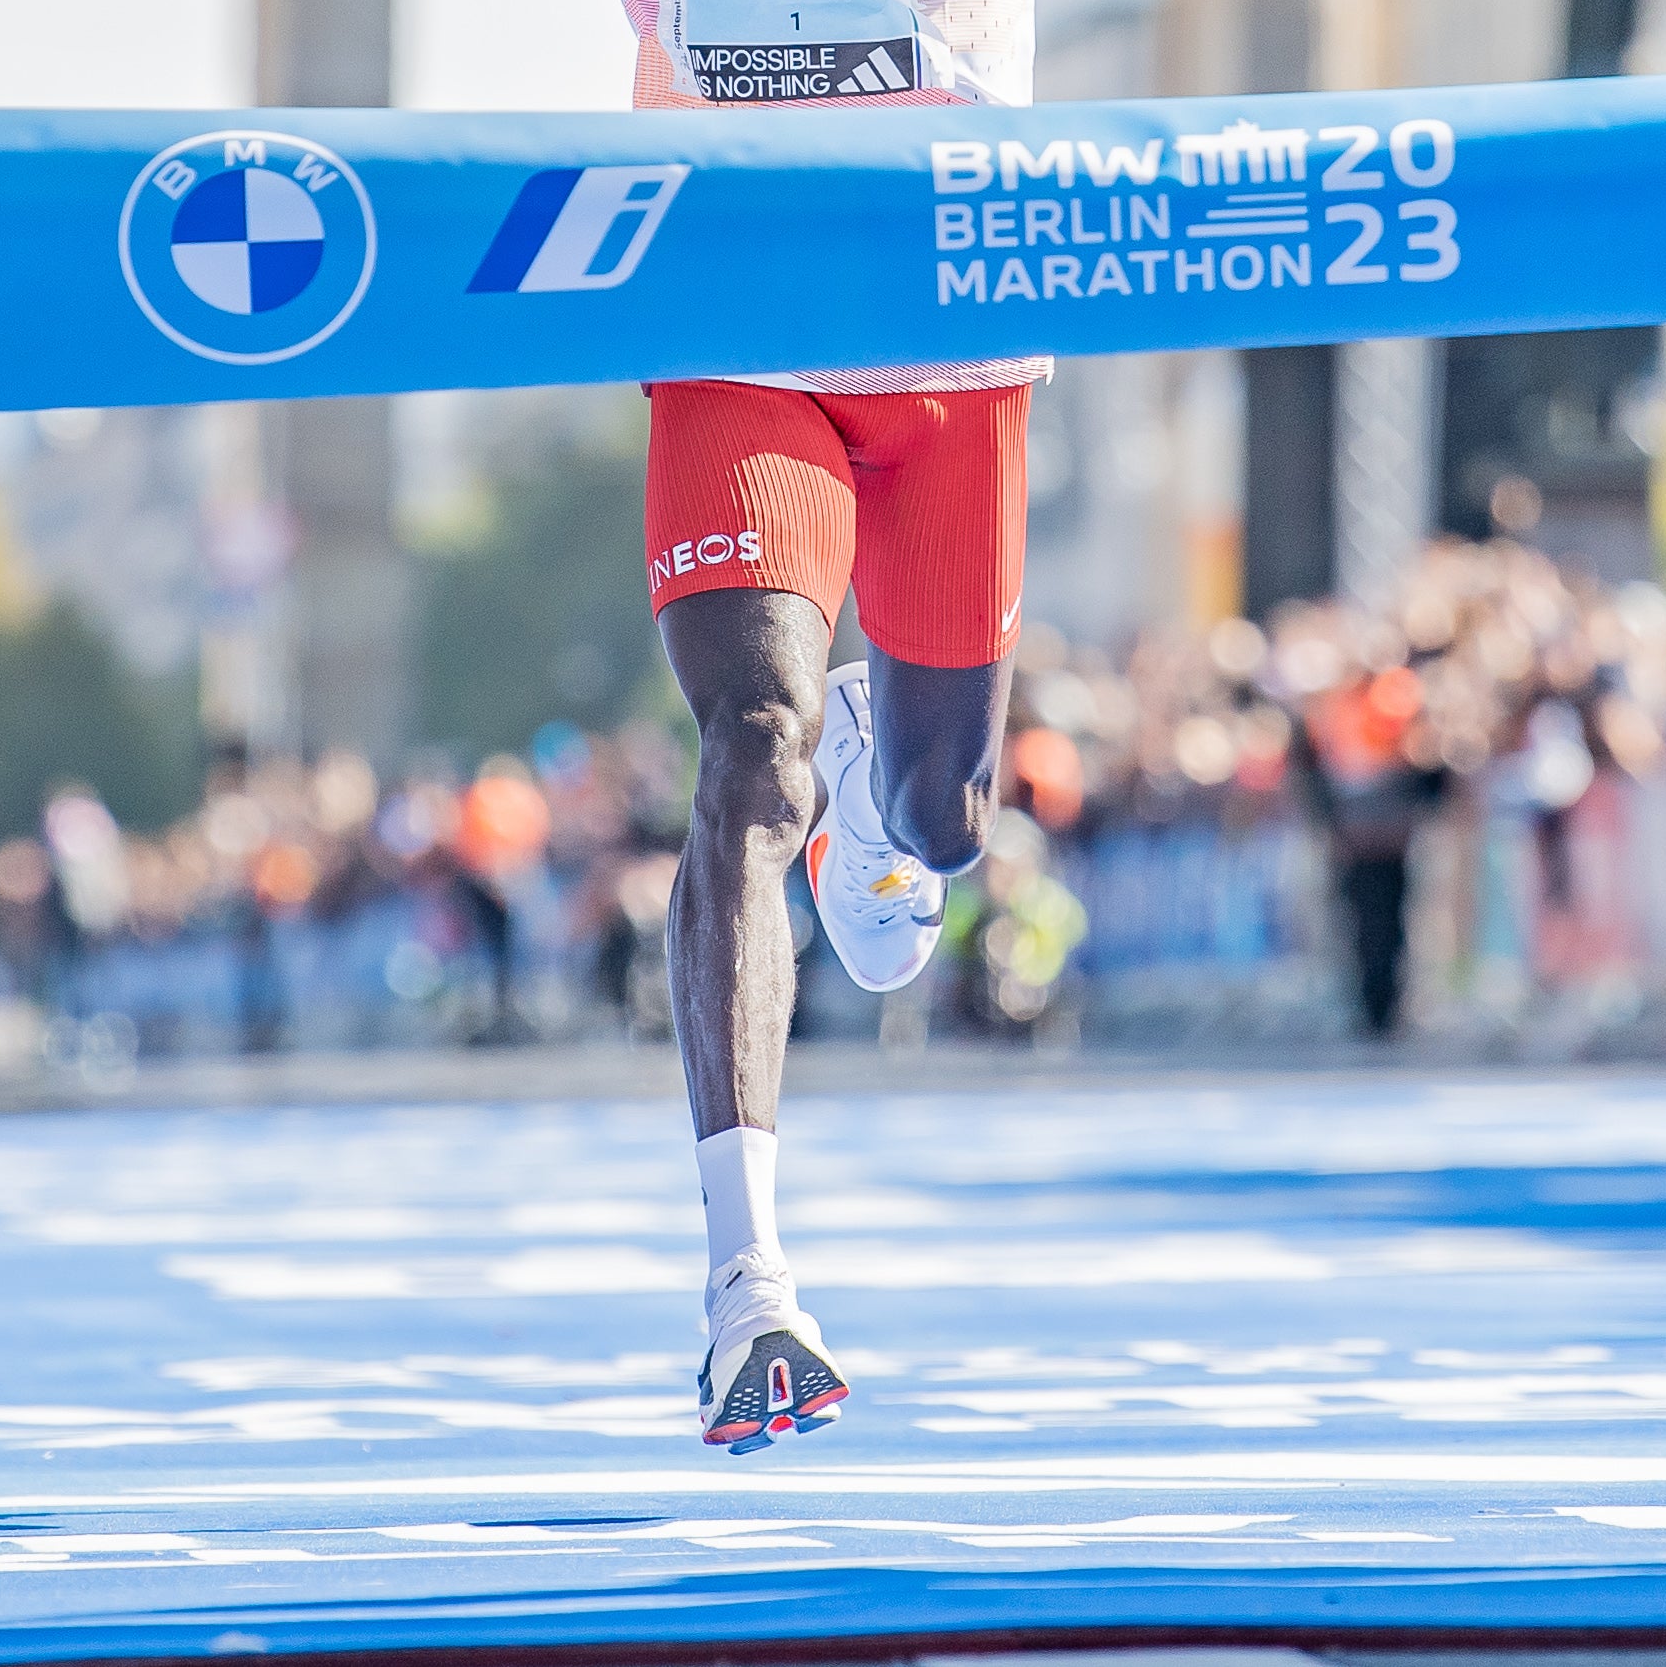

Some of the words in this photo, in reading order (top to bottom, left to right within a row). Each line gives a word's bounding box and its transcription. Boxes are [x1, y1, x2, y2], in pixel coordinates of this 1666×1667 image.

[790, 11, 801, 32] 1
[690, 47, 837, 73] IMPOSSIBLE
[715, 73, 831, 98] NOTHING
[153, 138, 343, 201] BMW
[931, 137, 1165, 196] BMW
[1321, 118, 1457, 192] 20
[936, 195, 1170, 250] BERLIN
[1326, 200, 1461, 284] 23
[937, 244, 1311, 305] MARATHON
[648, 530, 761, 594] INEOS
